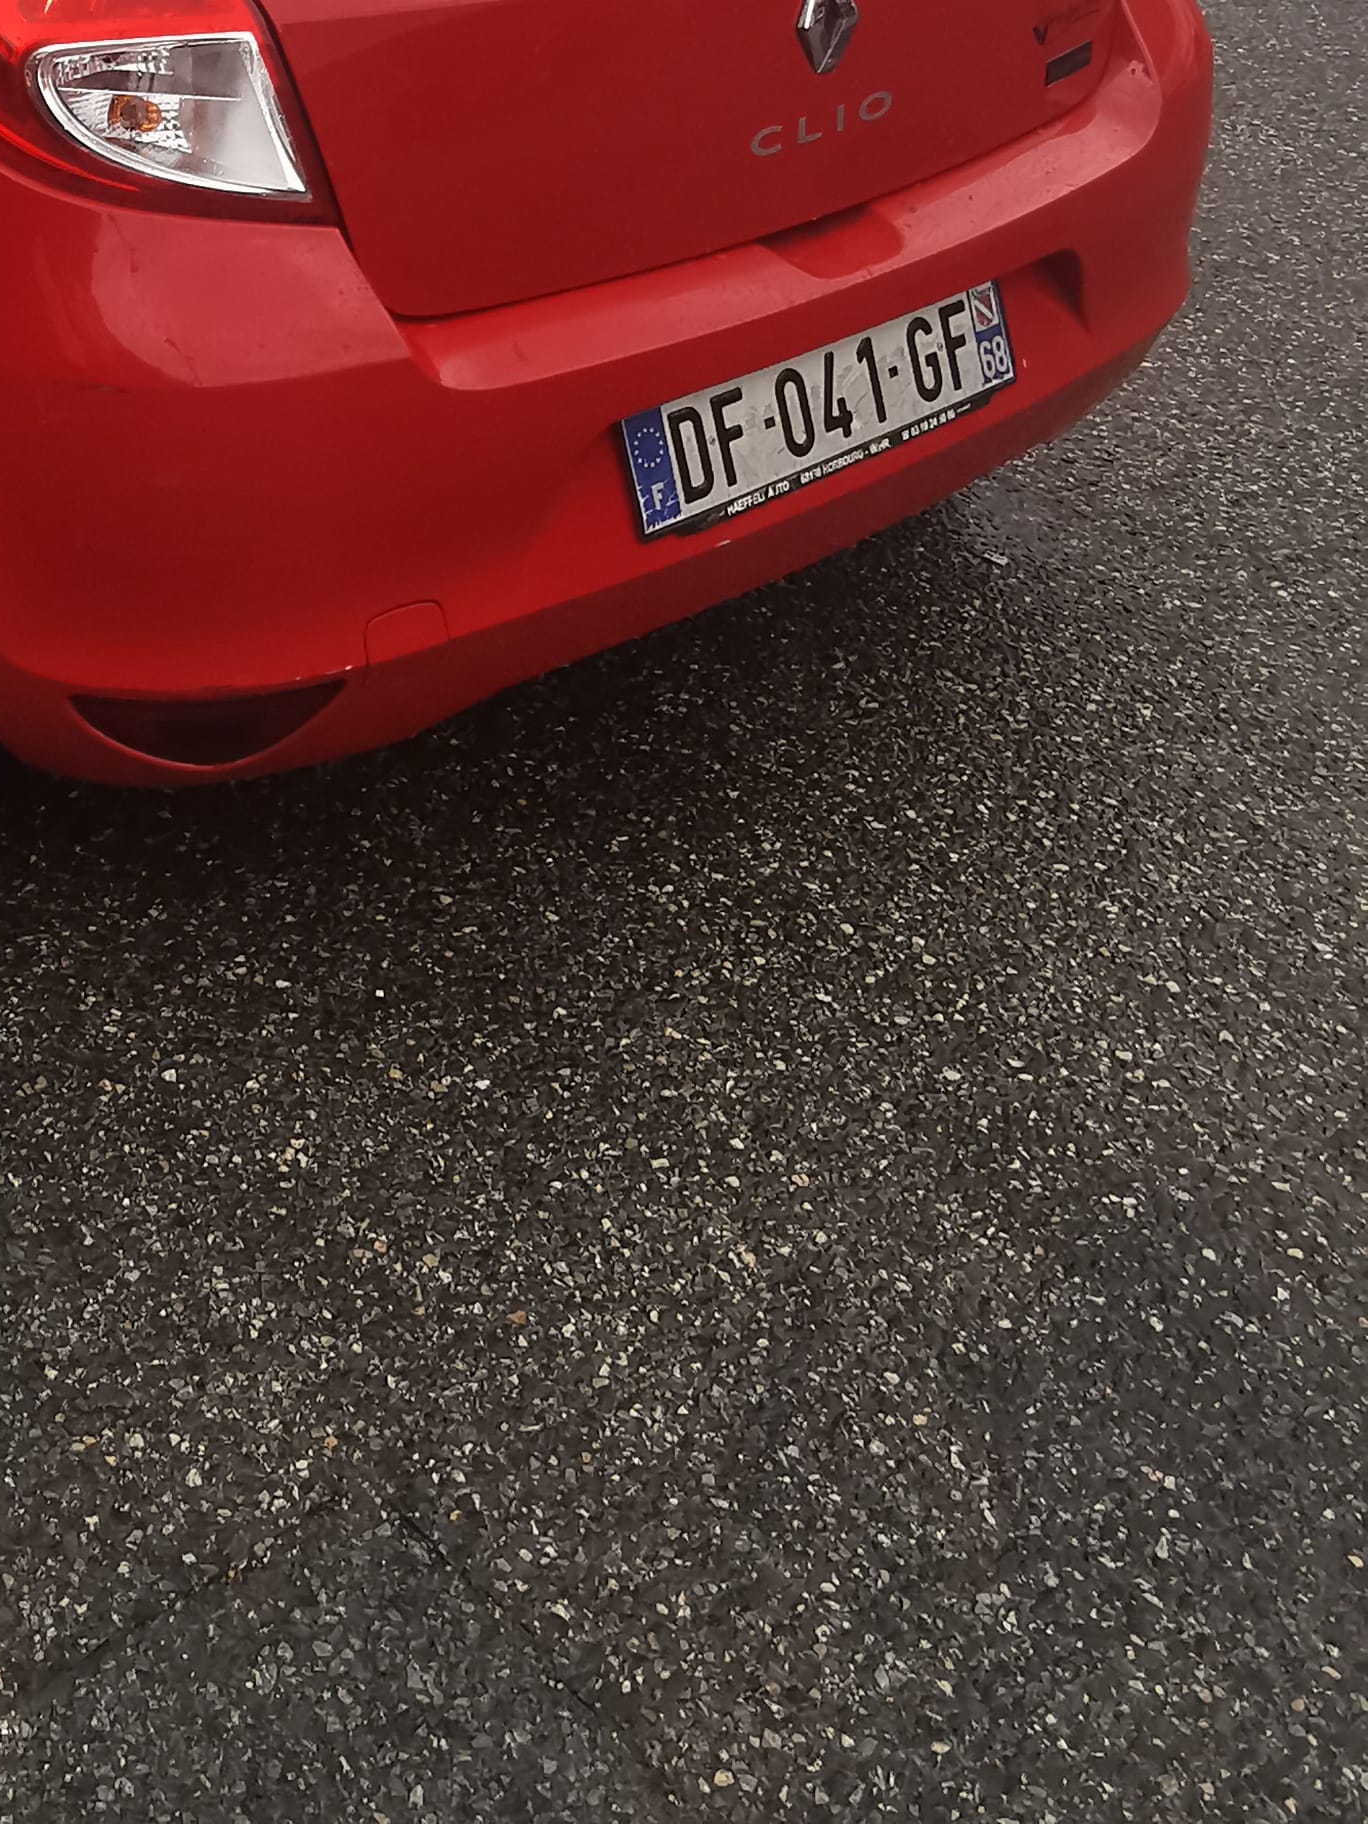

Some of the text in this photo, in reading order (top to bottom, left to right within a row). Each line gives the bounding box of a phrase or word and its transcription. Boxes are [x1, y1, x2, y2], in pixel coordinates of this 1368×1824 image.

[750, 90, 893, 157] CLIO
[978, 334, 1009, 377] 68
[667, 299, 968, 505] DF-041-GF
[650, 482, 665, 510] F
